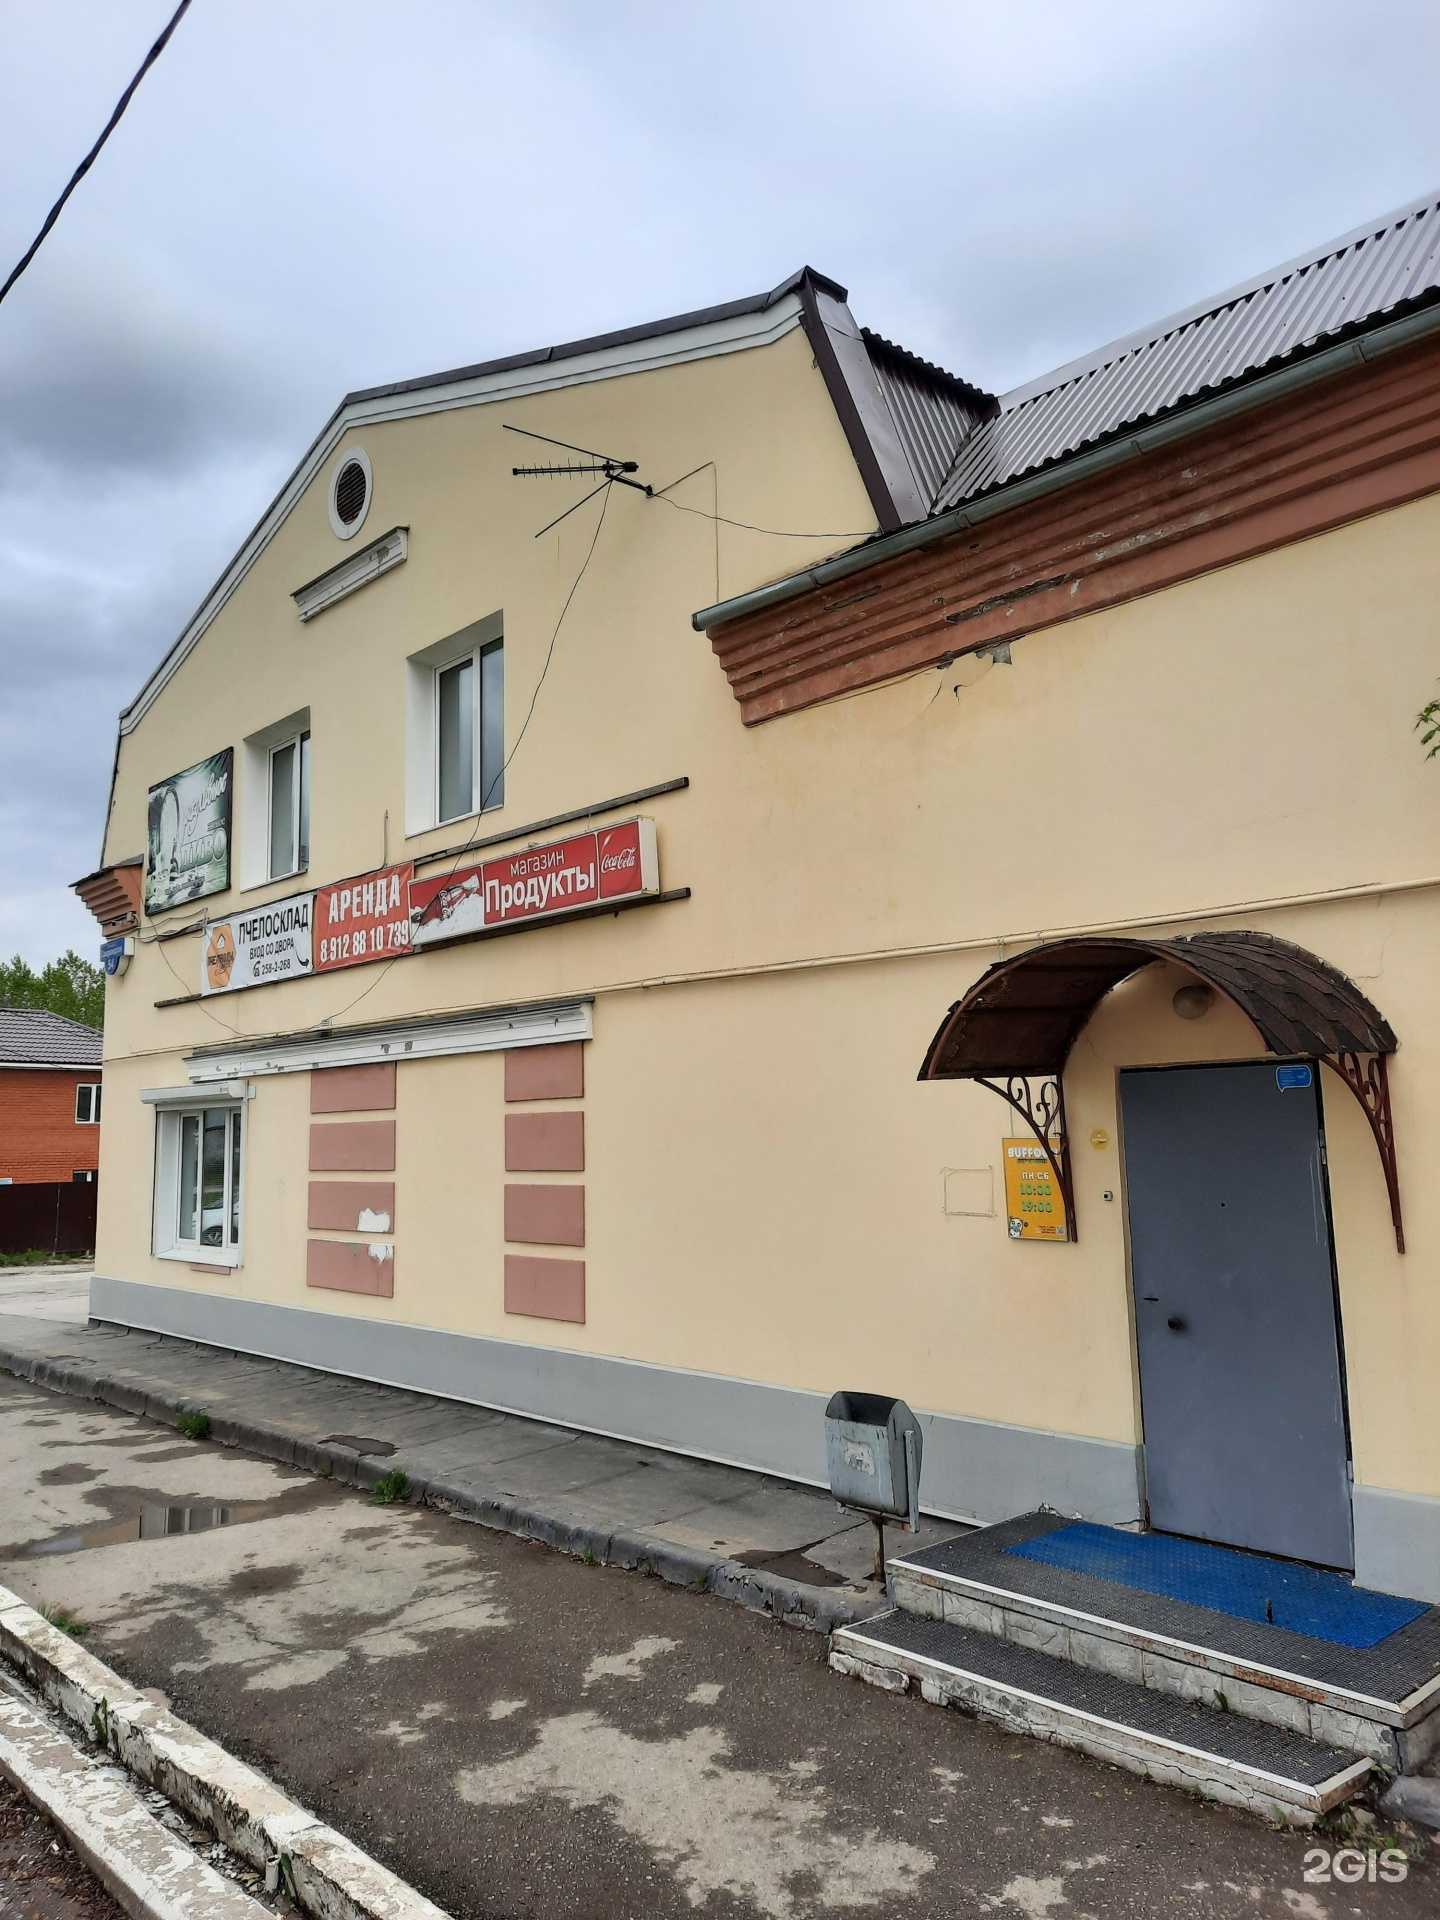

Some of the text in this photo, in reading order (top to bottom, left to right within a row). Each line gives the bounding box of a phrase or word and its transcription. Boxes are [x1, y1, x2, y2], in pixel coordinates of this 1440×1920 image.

[328, 874, 400, 924] АРЕНДА
[485, 862, 595, 917] Продукты
[238, 903, 309, 945] ПЧЕЛОСКЛАД
[265, 942, 274, 956] СО
[275, 936, 295, 954] ДВОРА
[320, 919, 409, 963] 8 912 88 10 739
